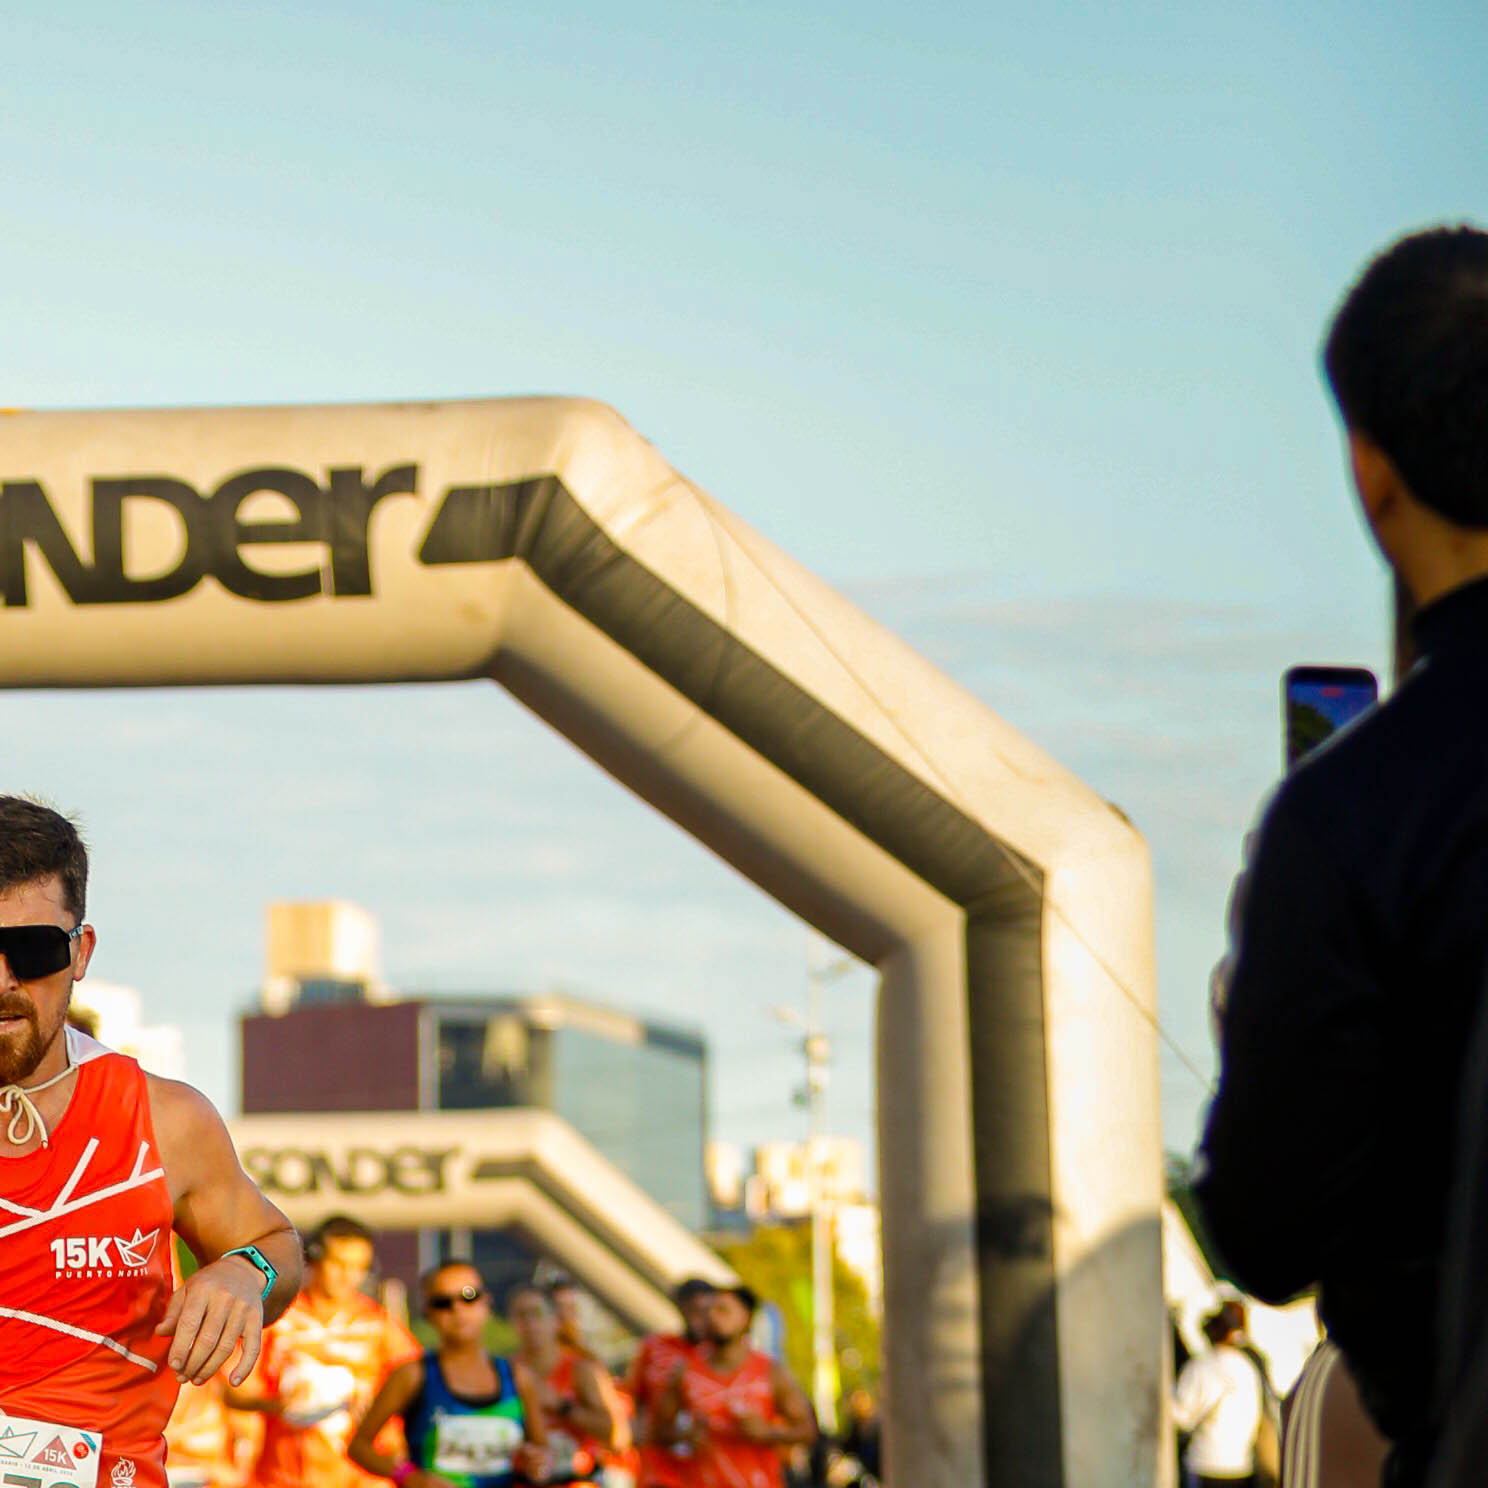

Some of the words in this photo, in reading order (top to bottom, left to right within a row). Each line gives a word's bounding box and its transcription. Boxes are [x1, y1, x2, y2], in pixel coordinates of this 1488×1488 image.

[50, 1237, 113, 1269] 15K
[55, 1270, 112, 1279] PUERTO
[43, 1449, 68, 1465] 15K
